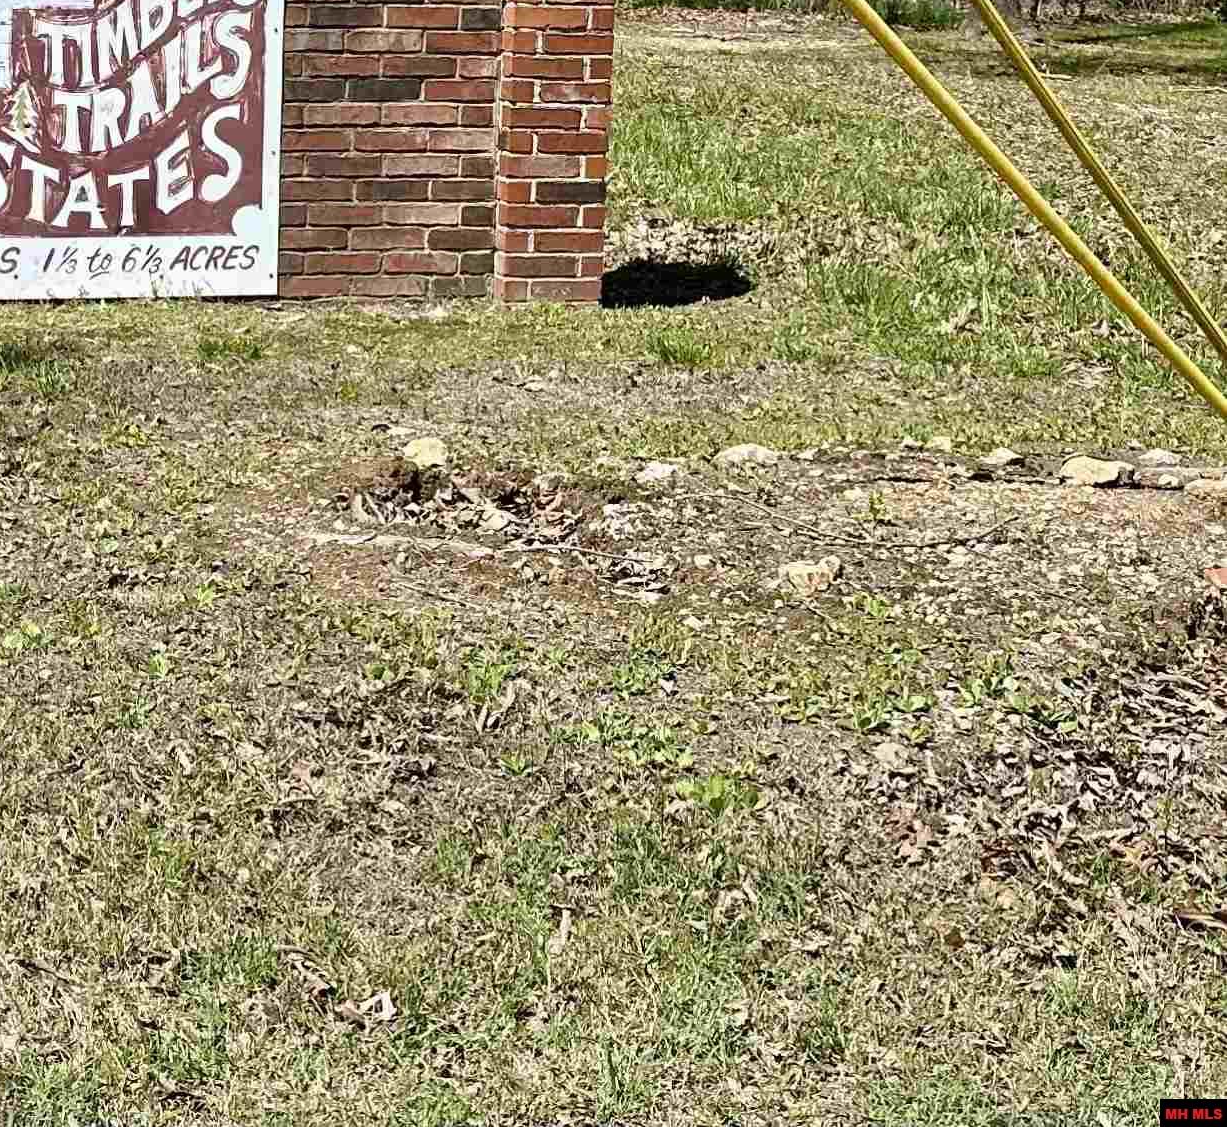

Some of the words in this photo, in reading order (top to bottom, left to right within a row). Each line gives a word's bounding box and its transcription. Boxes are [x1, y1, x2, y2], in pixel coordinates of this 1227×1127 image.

[52, 9, 254, 153] TRAILS
[86, 247, 114, 280] to
[169, 244, 261, 271] ACRES
